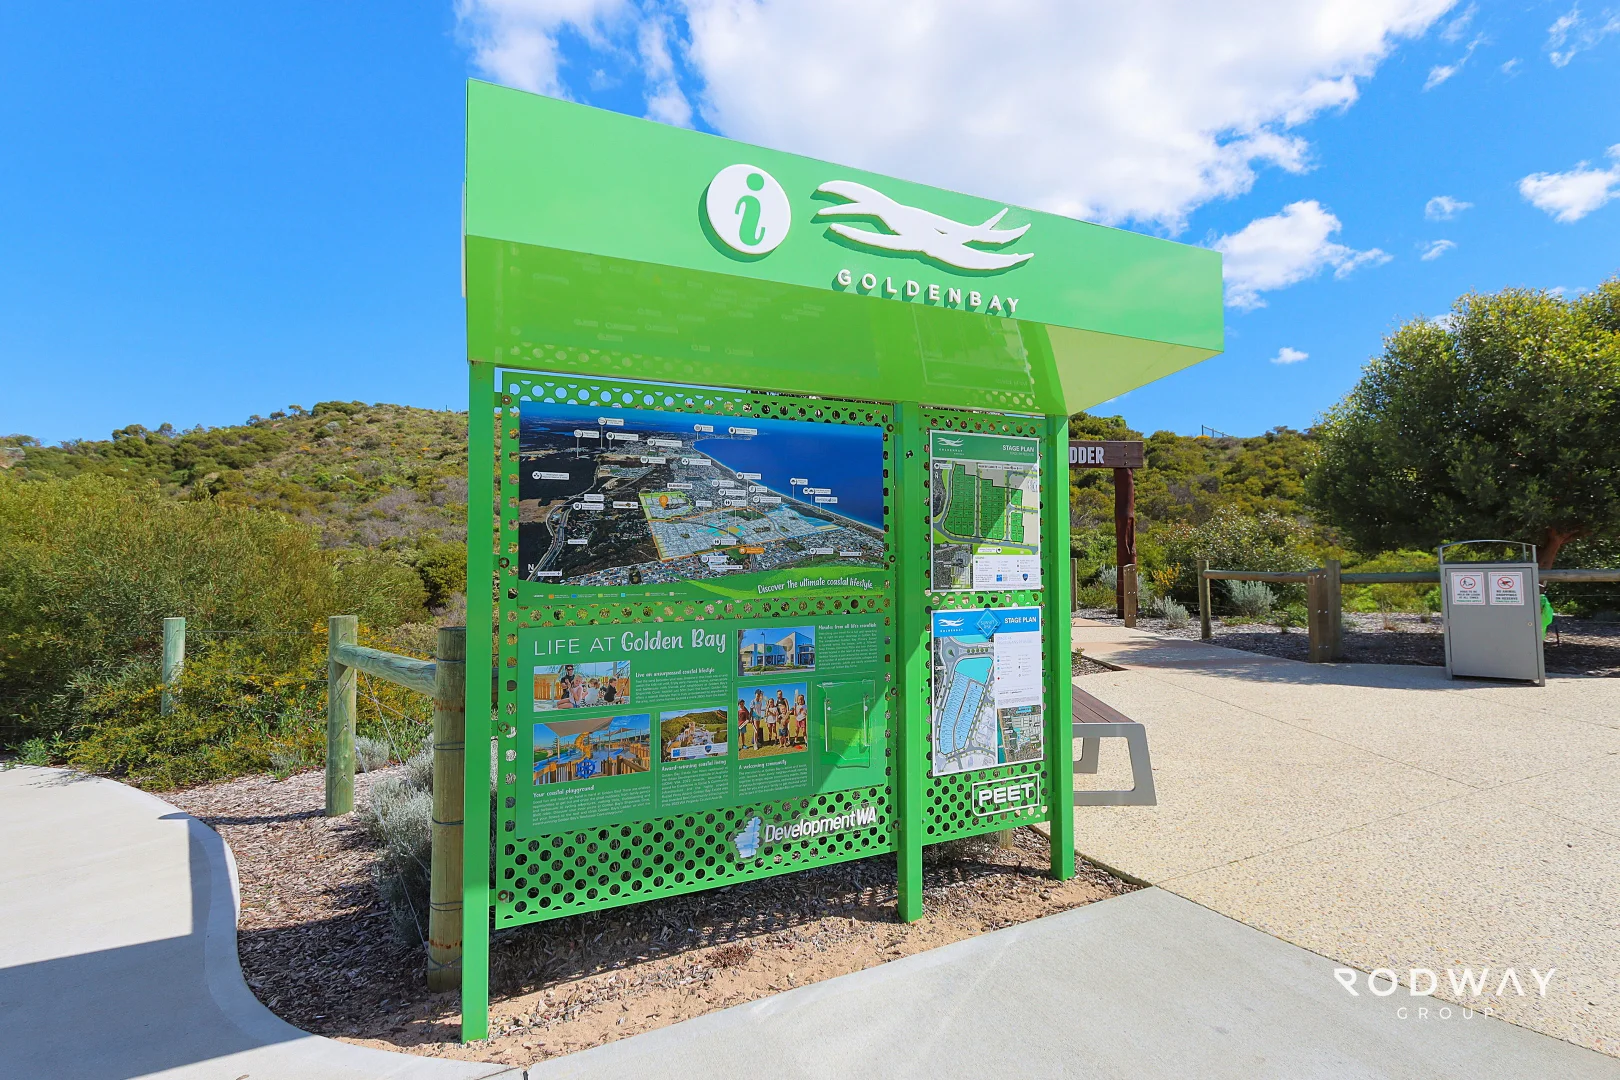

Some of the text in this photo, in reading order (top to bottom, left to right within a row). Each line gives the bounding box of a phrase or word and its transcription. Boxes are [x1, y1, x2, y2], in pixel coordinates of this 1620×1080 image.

[836, 268, 1020, 313] GOLDENBAY
[1002, 444, 1035, 453] STAGE PLAN
[757, 576, 873, 594] Discover the ultimate coastal lifestyle
[534, 628, 726, 656] LIFE AT Golden Bay
[546, 788, 564, 797] coastal
[565, 785, 595, 795] playground
[978, 782, 1035, 807] PEET
[764, 806, 877, 843] DevelopmentWA
